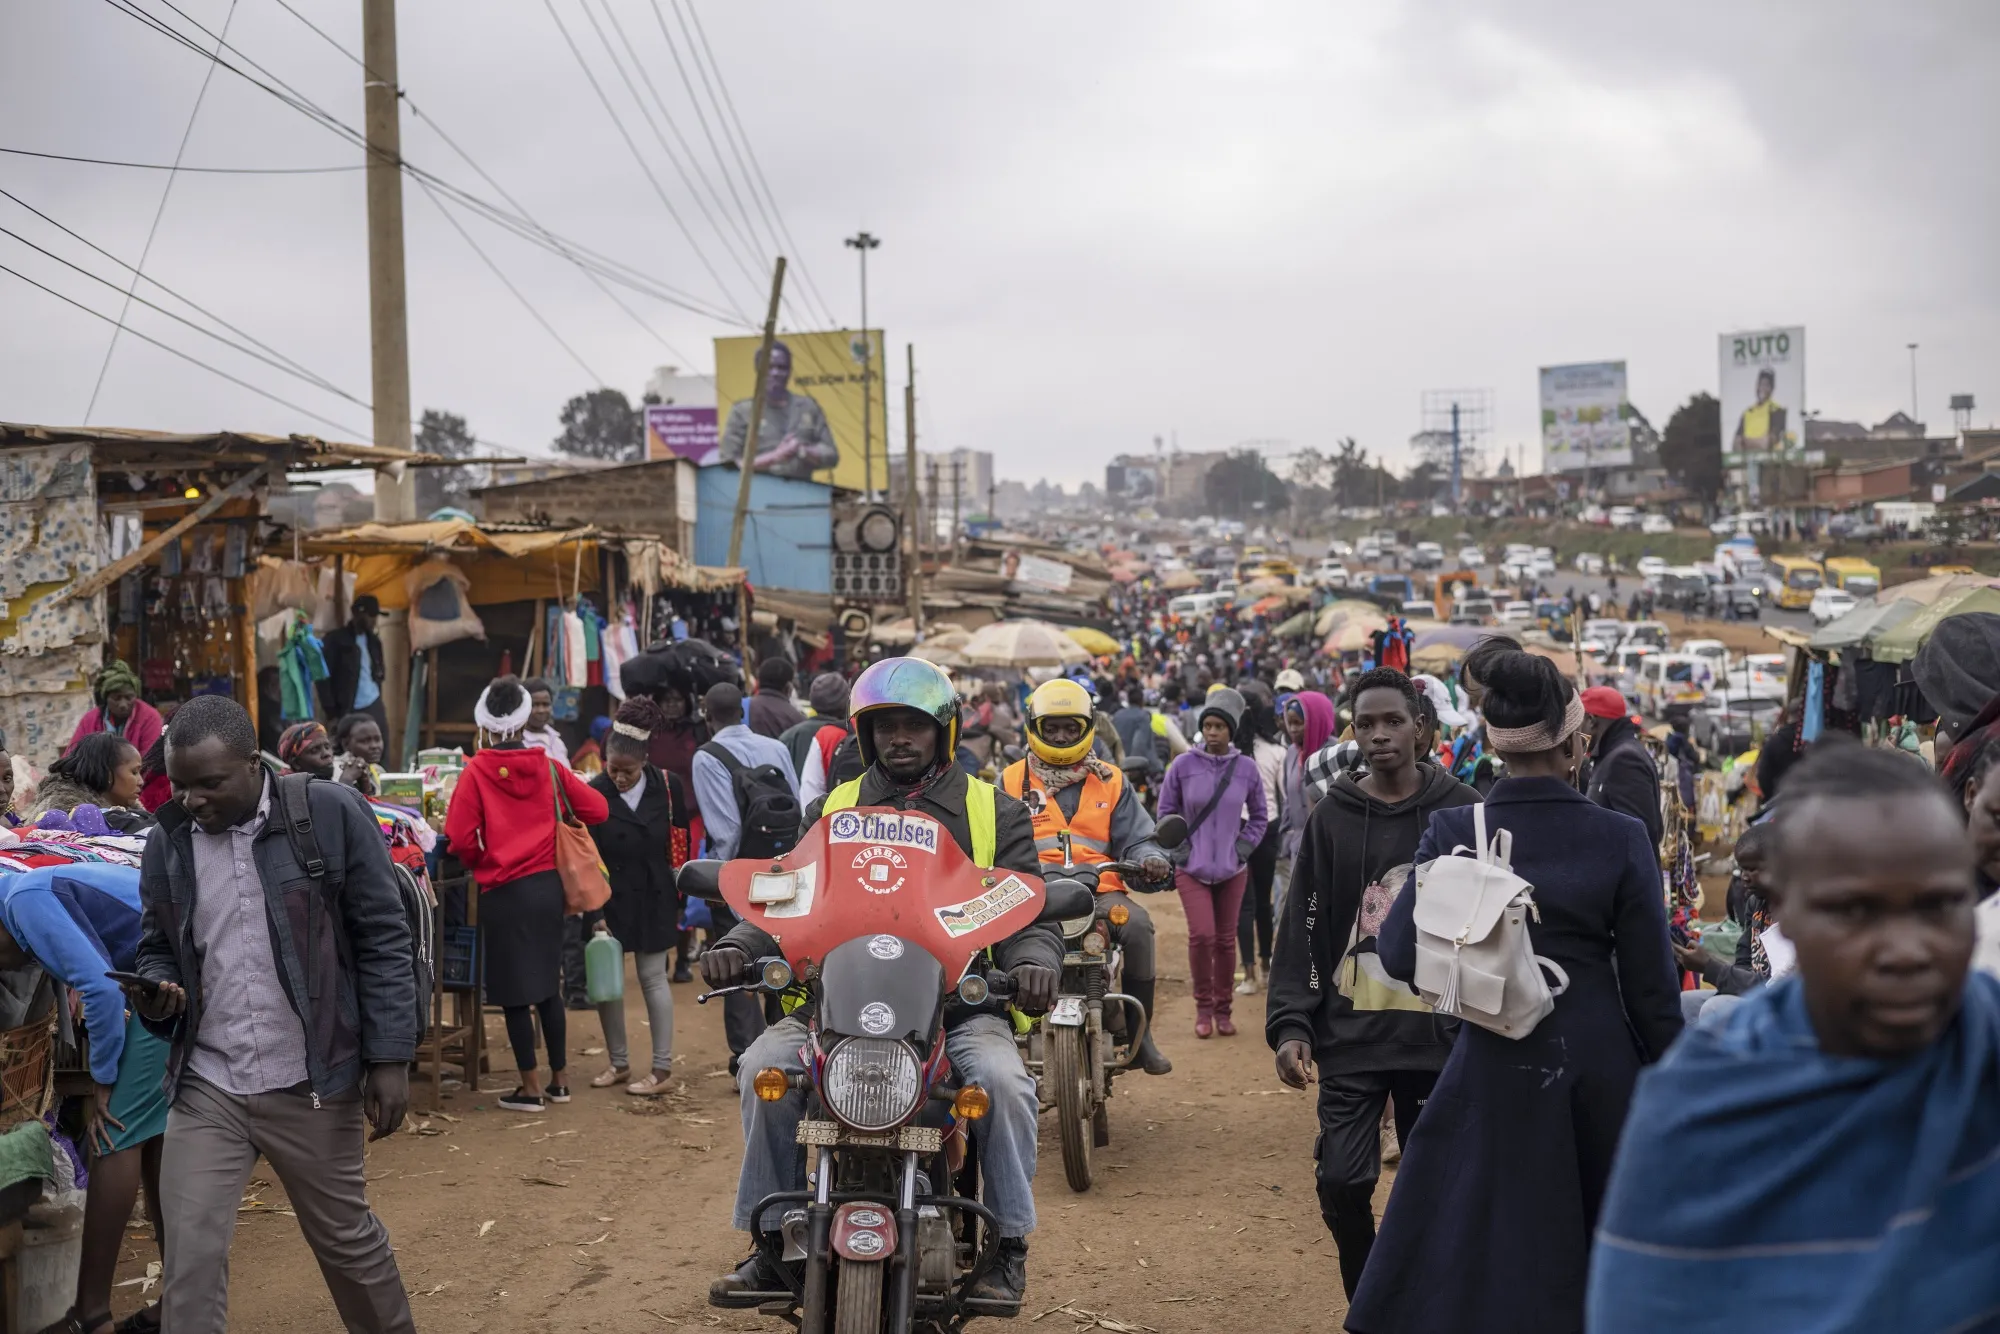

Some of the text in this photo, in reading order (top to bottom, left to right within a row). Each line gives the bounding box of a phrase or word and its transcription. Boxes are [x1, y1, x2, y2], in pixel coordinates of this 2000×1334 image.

[1733, 333, 1790, 360] RUTO
[863, 816, 935, 849] Chelsea
[856, 848, 902, 864] TURBO
[857, 876, 906, 895] POWER
[962, 879, 1020, 915] GOD LOVES
[972, 888, 1030, 926] OUR NATION
